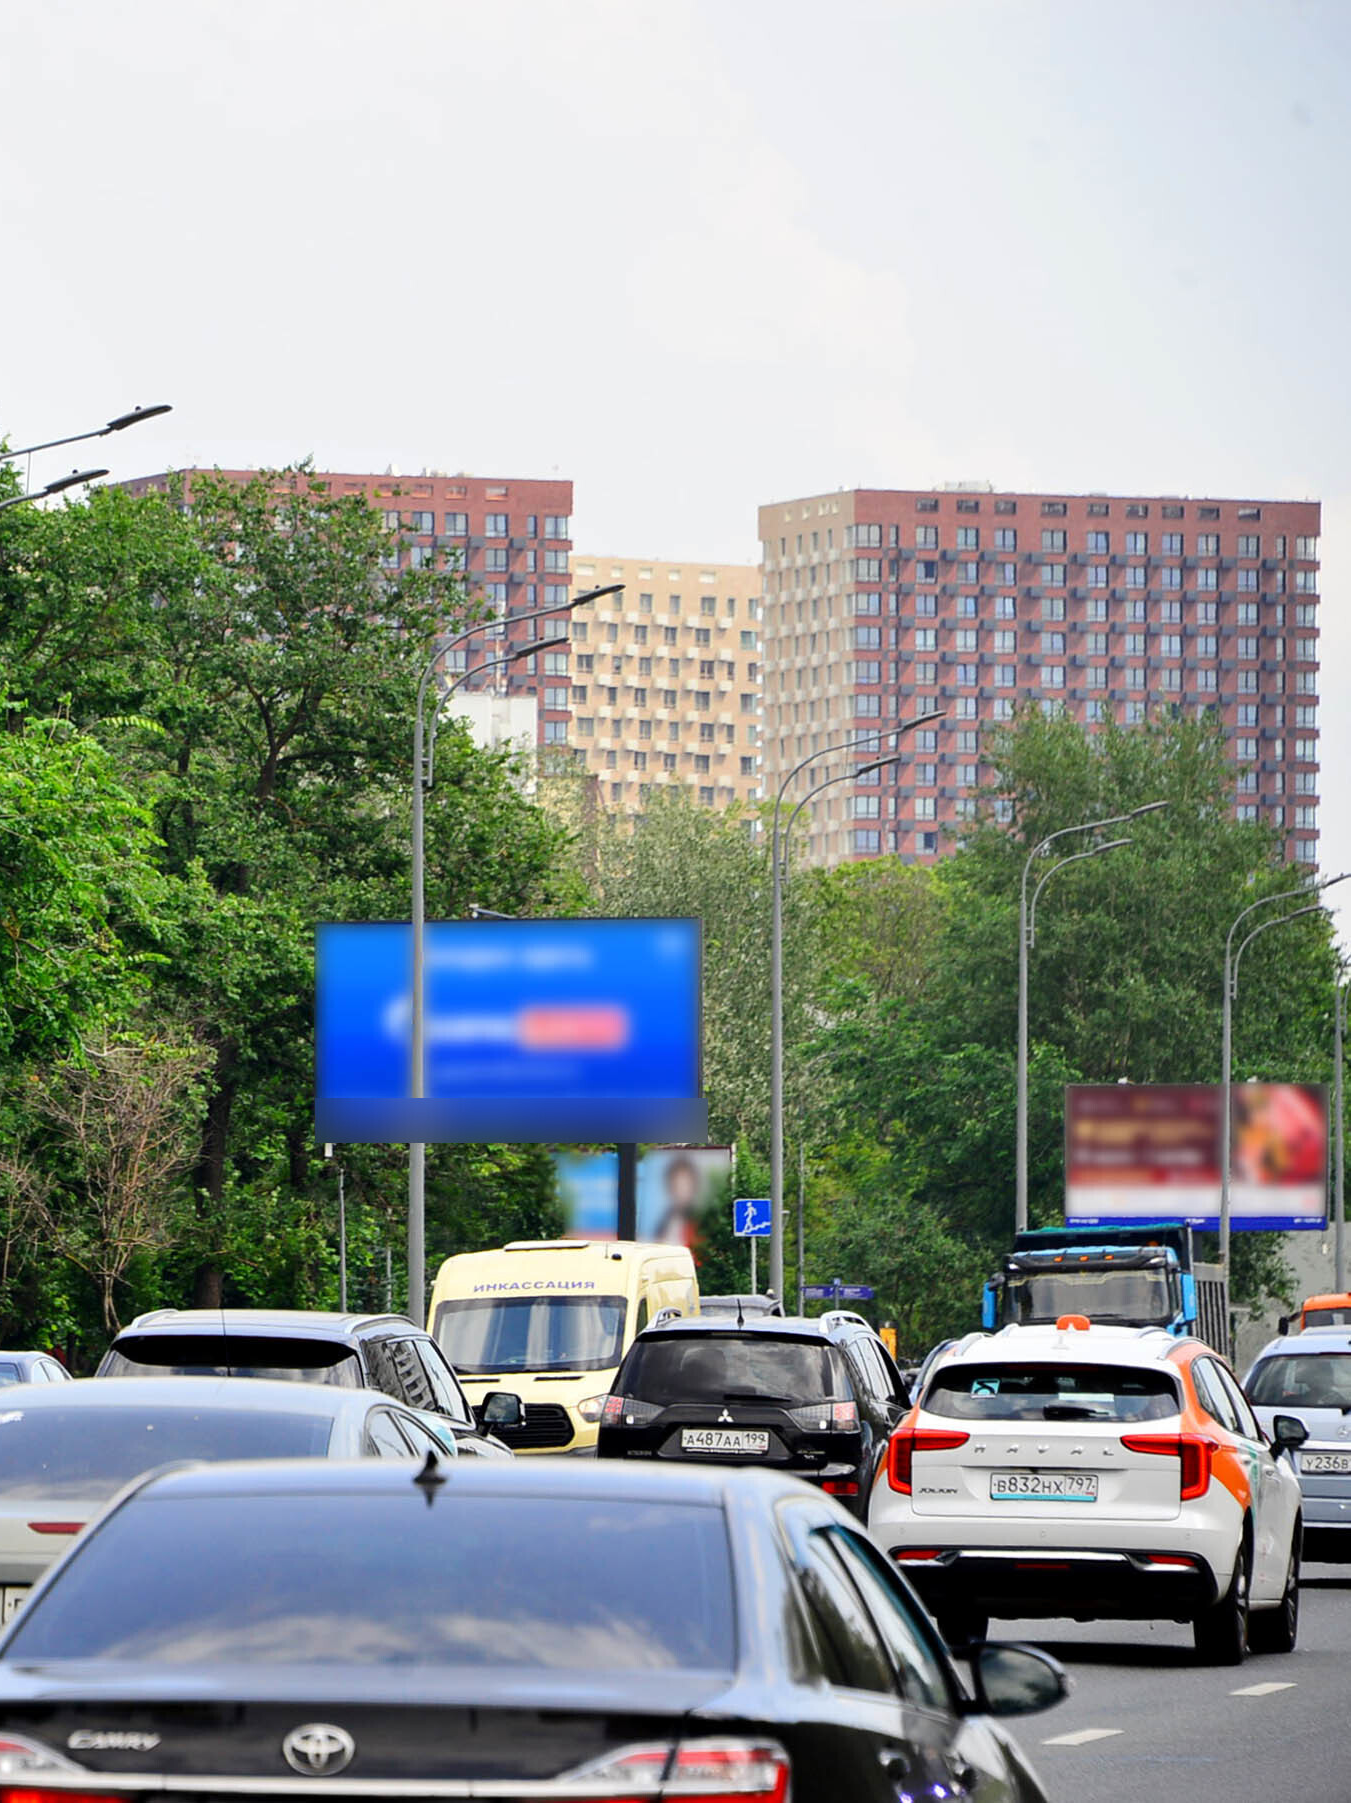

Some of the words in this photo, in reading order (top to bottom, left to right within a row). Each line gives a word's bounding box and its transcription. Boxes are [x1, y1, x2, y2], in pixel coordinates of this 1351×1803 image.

[473, 1281, 595, 1293] ИНКАССАЦИЯ
[686, 1432, 741, 1447] А487АА
[745, 1433, 766, 1444] 199
[997, 1476, 1063, 1494] В832НХ
[1067, 1477, 1093, 1490] 797
